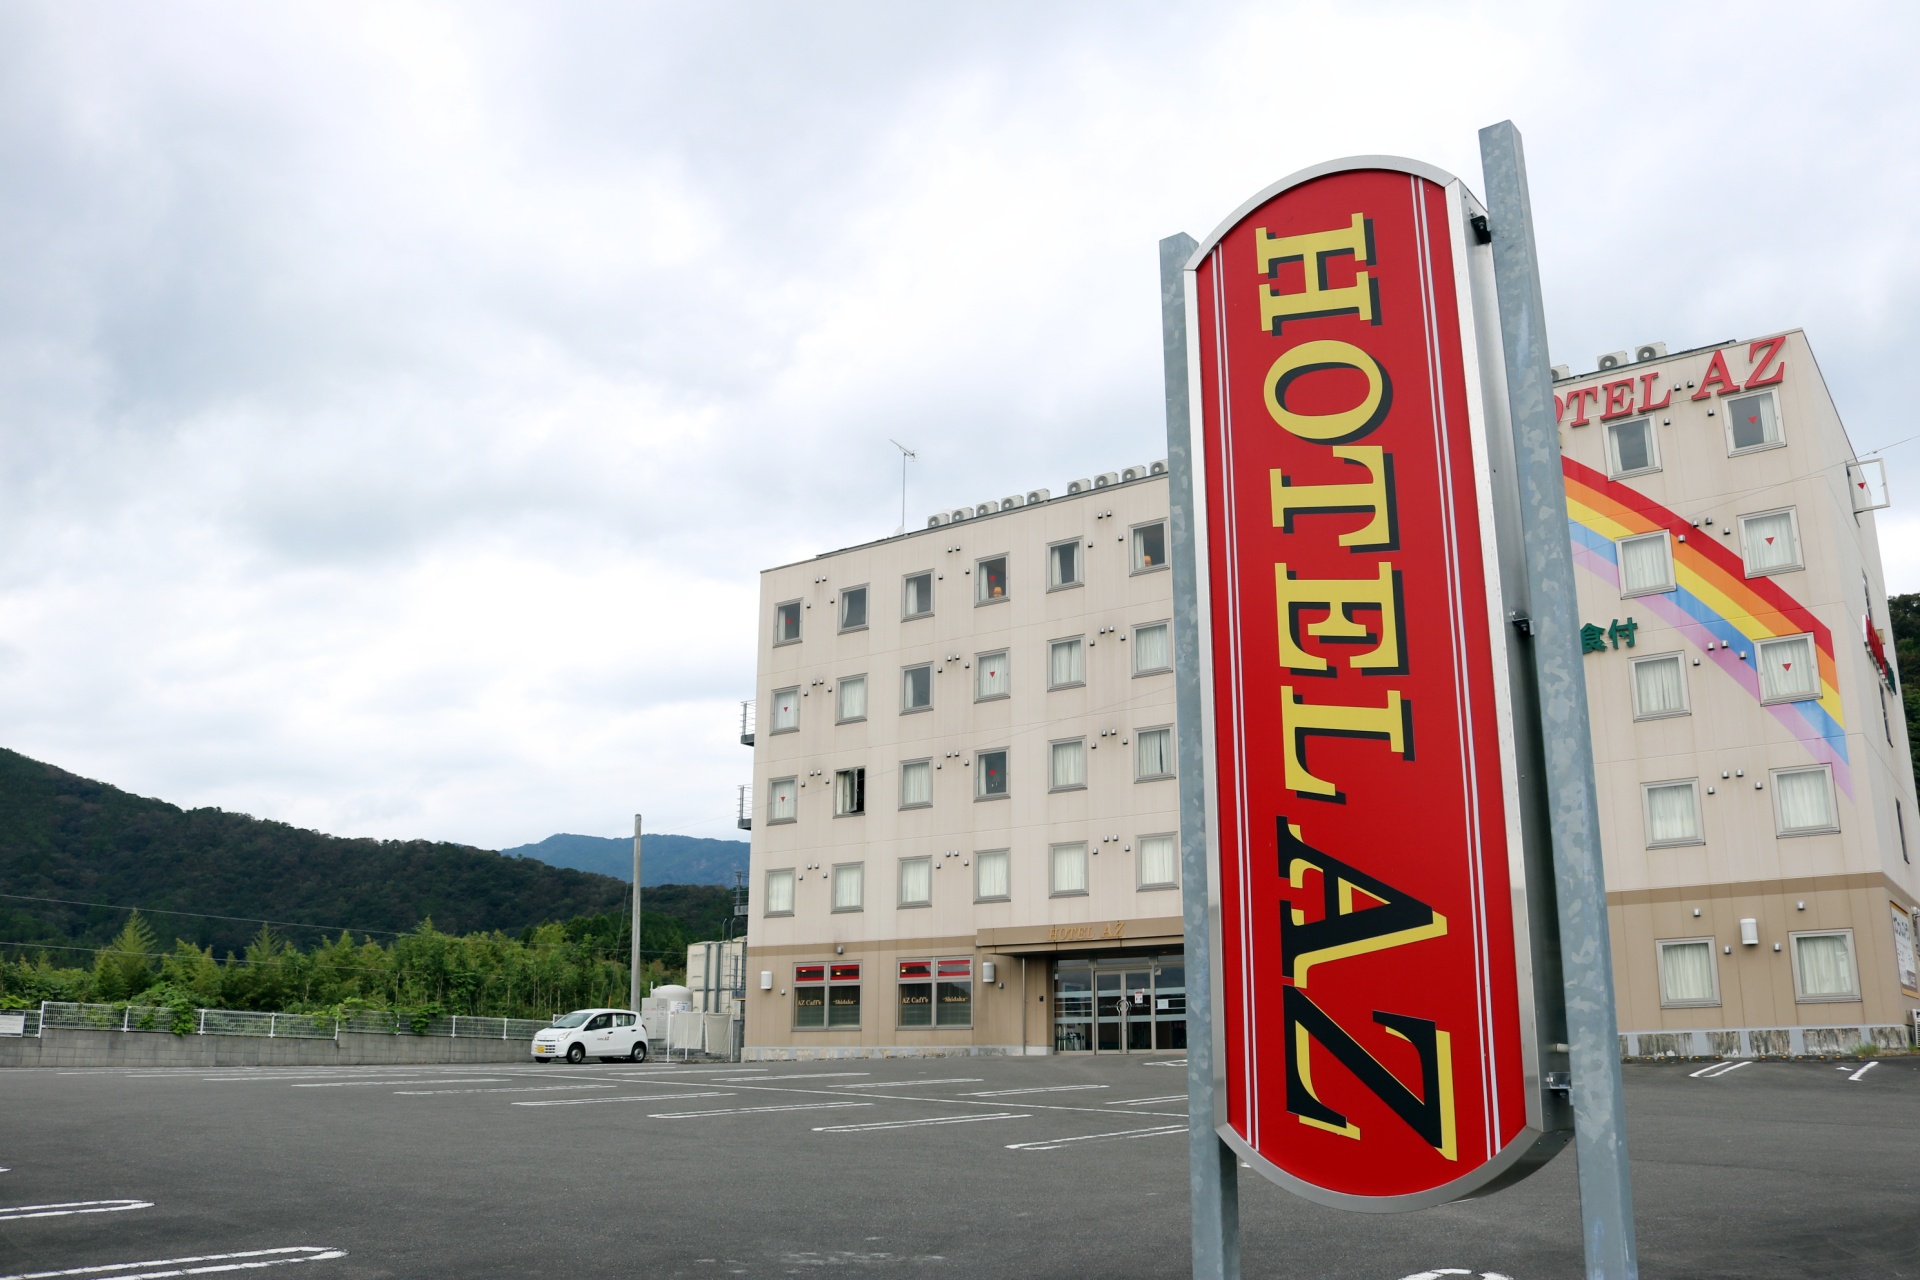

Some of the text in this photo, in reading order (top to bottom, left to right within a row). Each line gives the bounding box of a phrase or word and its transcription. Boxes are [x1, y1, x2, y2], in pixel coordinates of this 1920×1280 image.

[1691, 335, 1787, 401] AZ
[1255, 212, 1458, 1162] HOTEL AZ
[1047, 921, 1126, 941] HOTEL AZ
